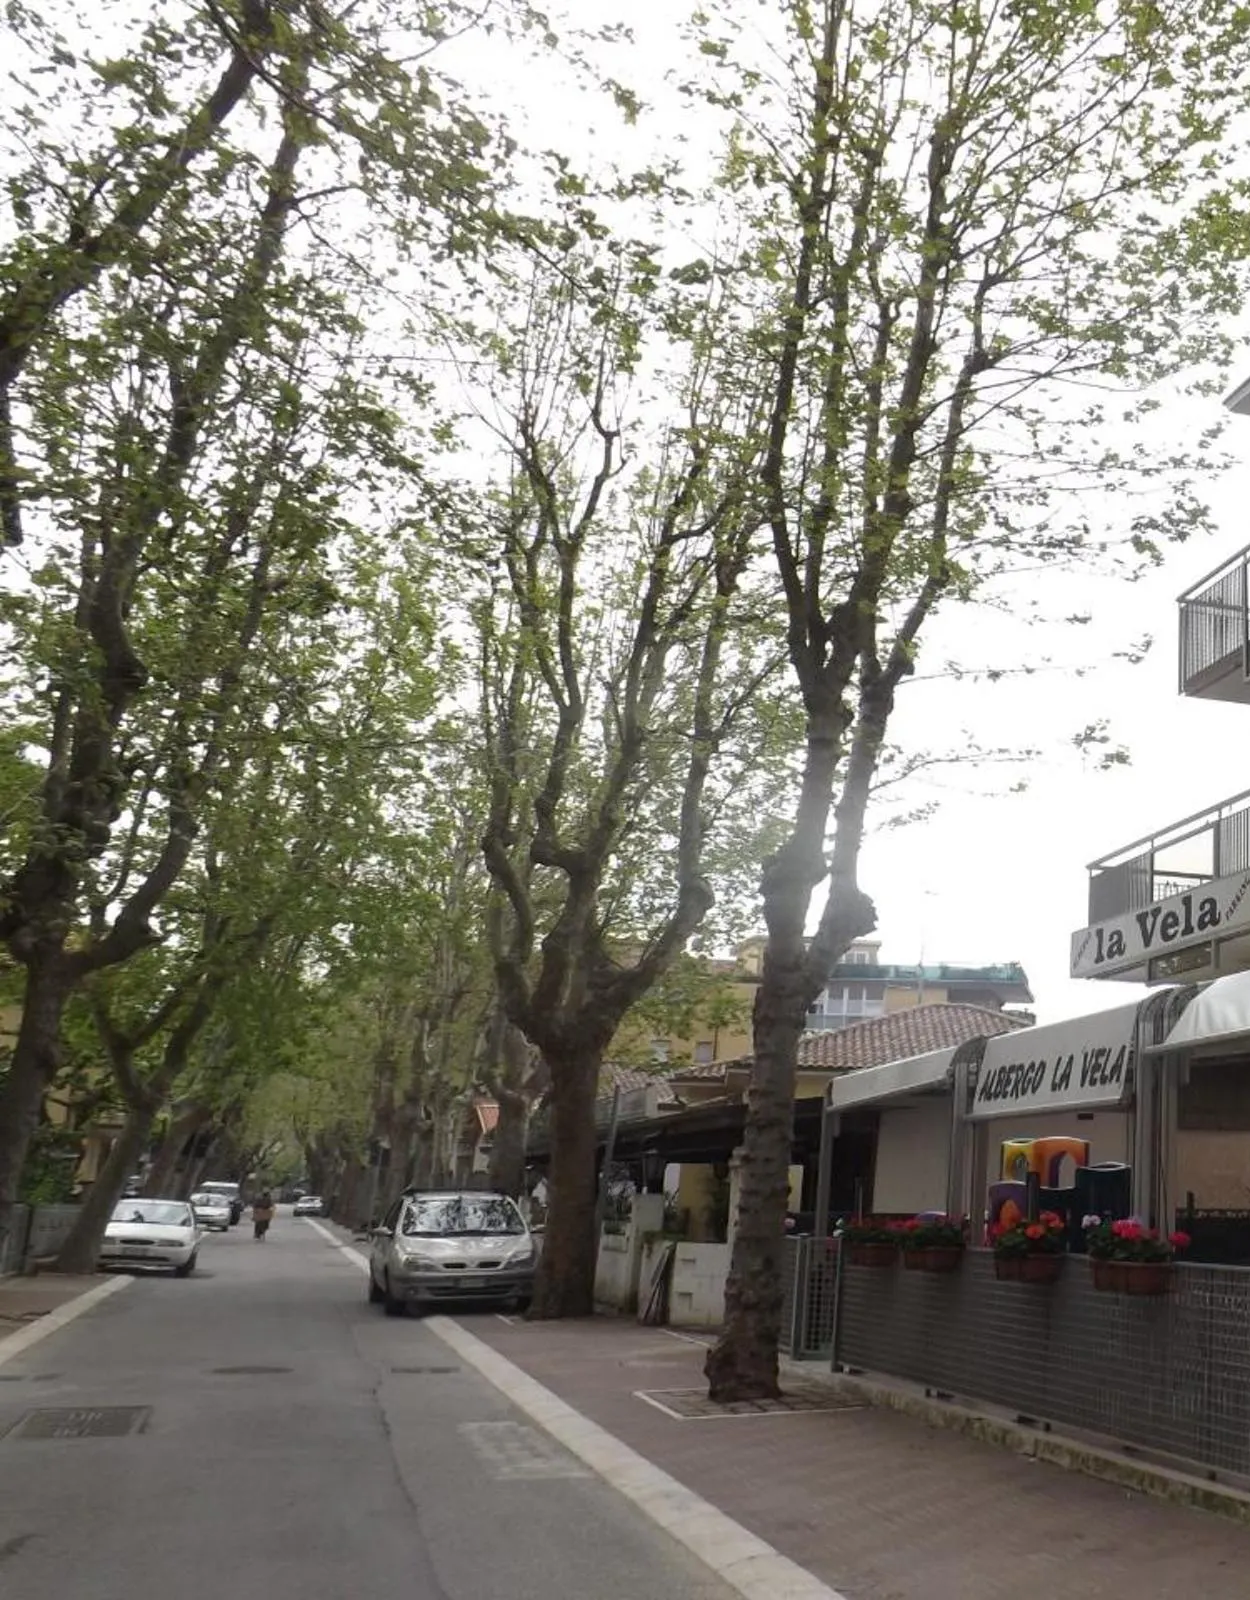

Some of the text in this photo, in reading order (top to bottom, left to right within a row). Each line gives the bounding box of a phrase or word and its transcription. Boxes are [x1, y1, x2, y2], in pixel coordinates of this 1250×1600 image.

[1094, 928, 1126, 964] la
[1136, 894, 1221, 948] Vela
[978, 1045, 1127, 1102] ALBERGO LA VELA
